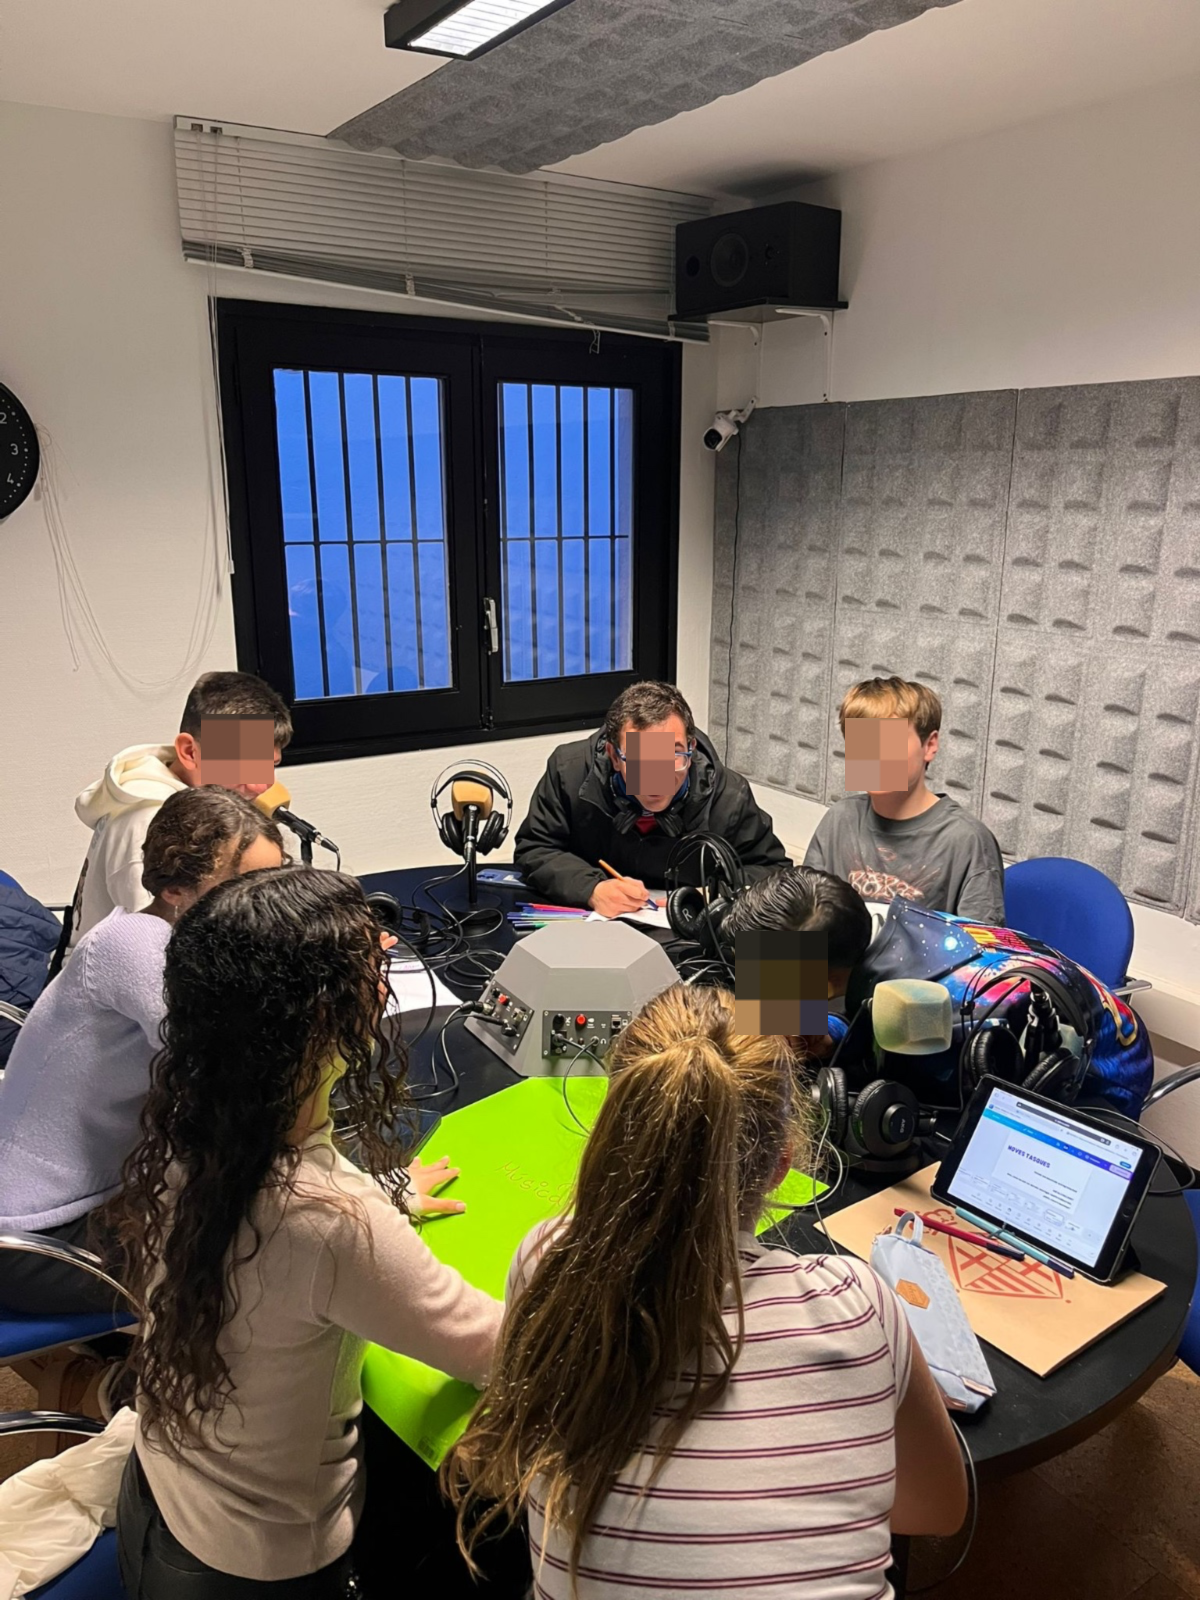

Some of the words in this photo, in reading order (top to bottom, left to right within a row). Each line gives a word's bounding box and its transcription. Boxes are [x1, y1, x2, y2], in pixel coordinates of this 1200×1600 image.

[10, 443, 18, 455] 3
[7, 473, 14, 484] 4
[682, 908, 693, 922] R
[1007, 1145, 1025, 1157] NOVES
[1026, 1153, 1051, 1168] TASQUES
